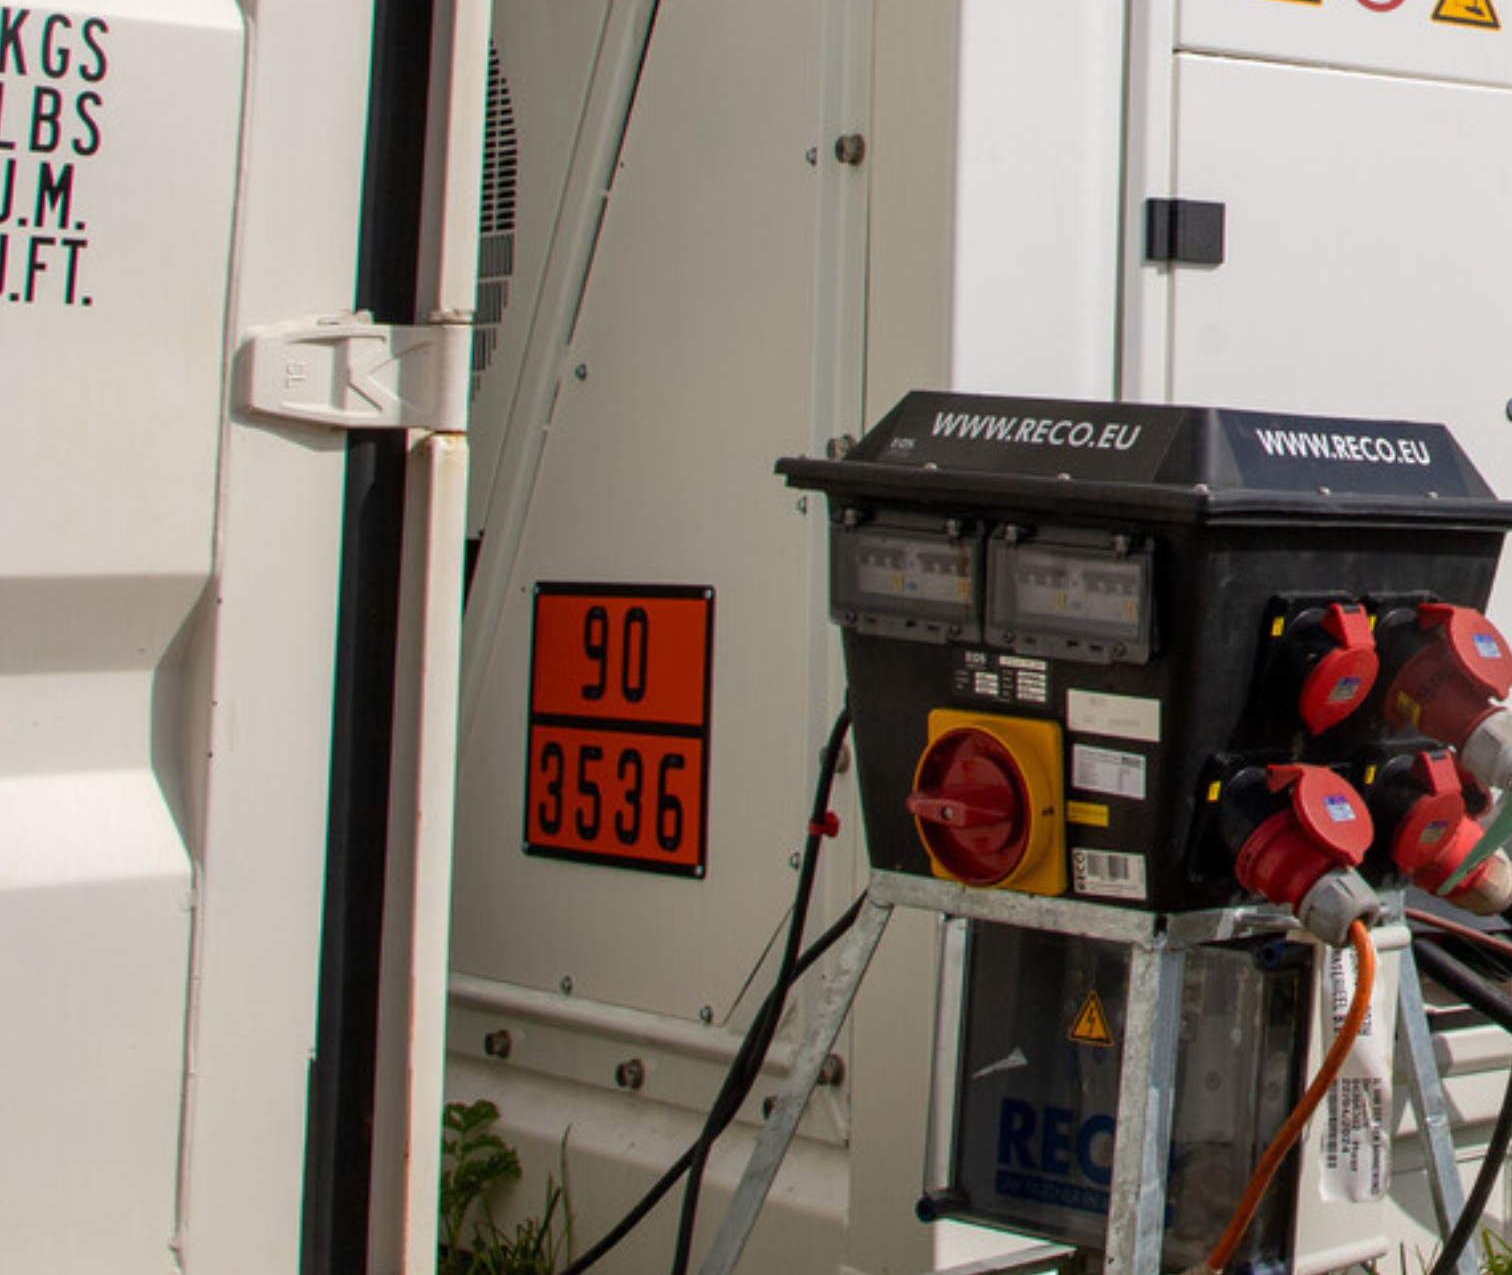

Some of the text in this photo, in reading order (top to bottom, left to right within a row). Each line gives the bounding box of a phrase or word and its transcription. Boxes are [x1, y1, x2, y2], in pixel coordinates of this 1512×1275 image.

[0, 7, 109, 82] KGS
[931, 411, 1141, 451] WWW.RECO.EU
[1255, 428, 1431, 466] WWW.RECO.EU
[580, 605, 650, 703] 90
[537, 740, 685, 853] 3536
[998, 1097, 1116, 1186] REC
